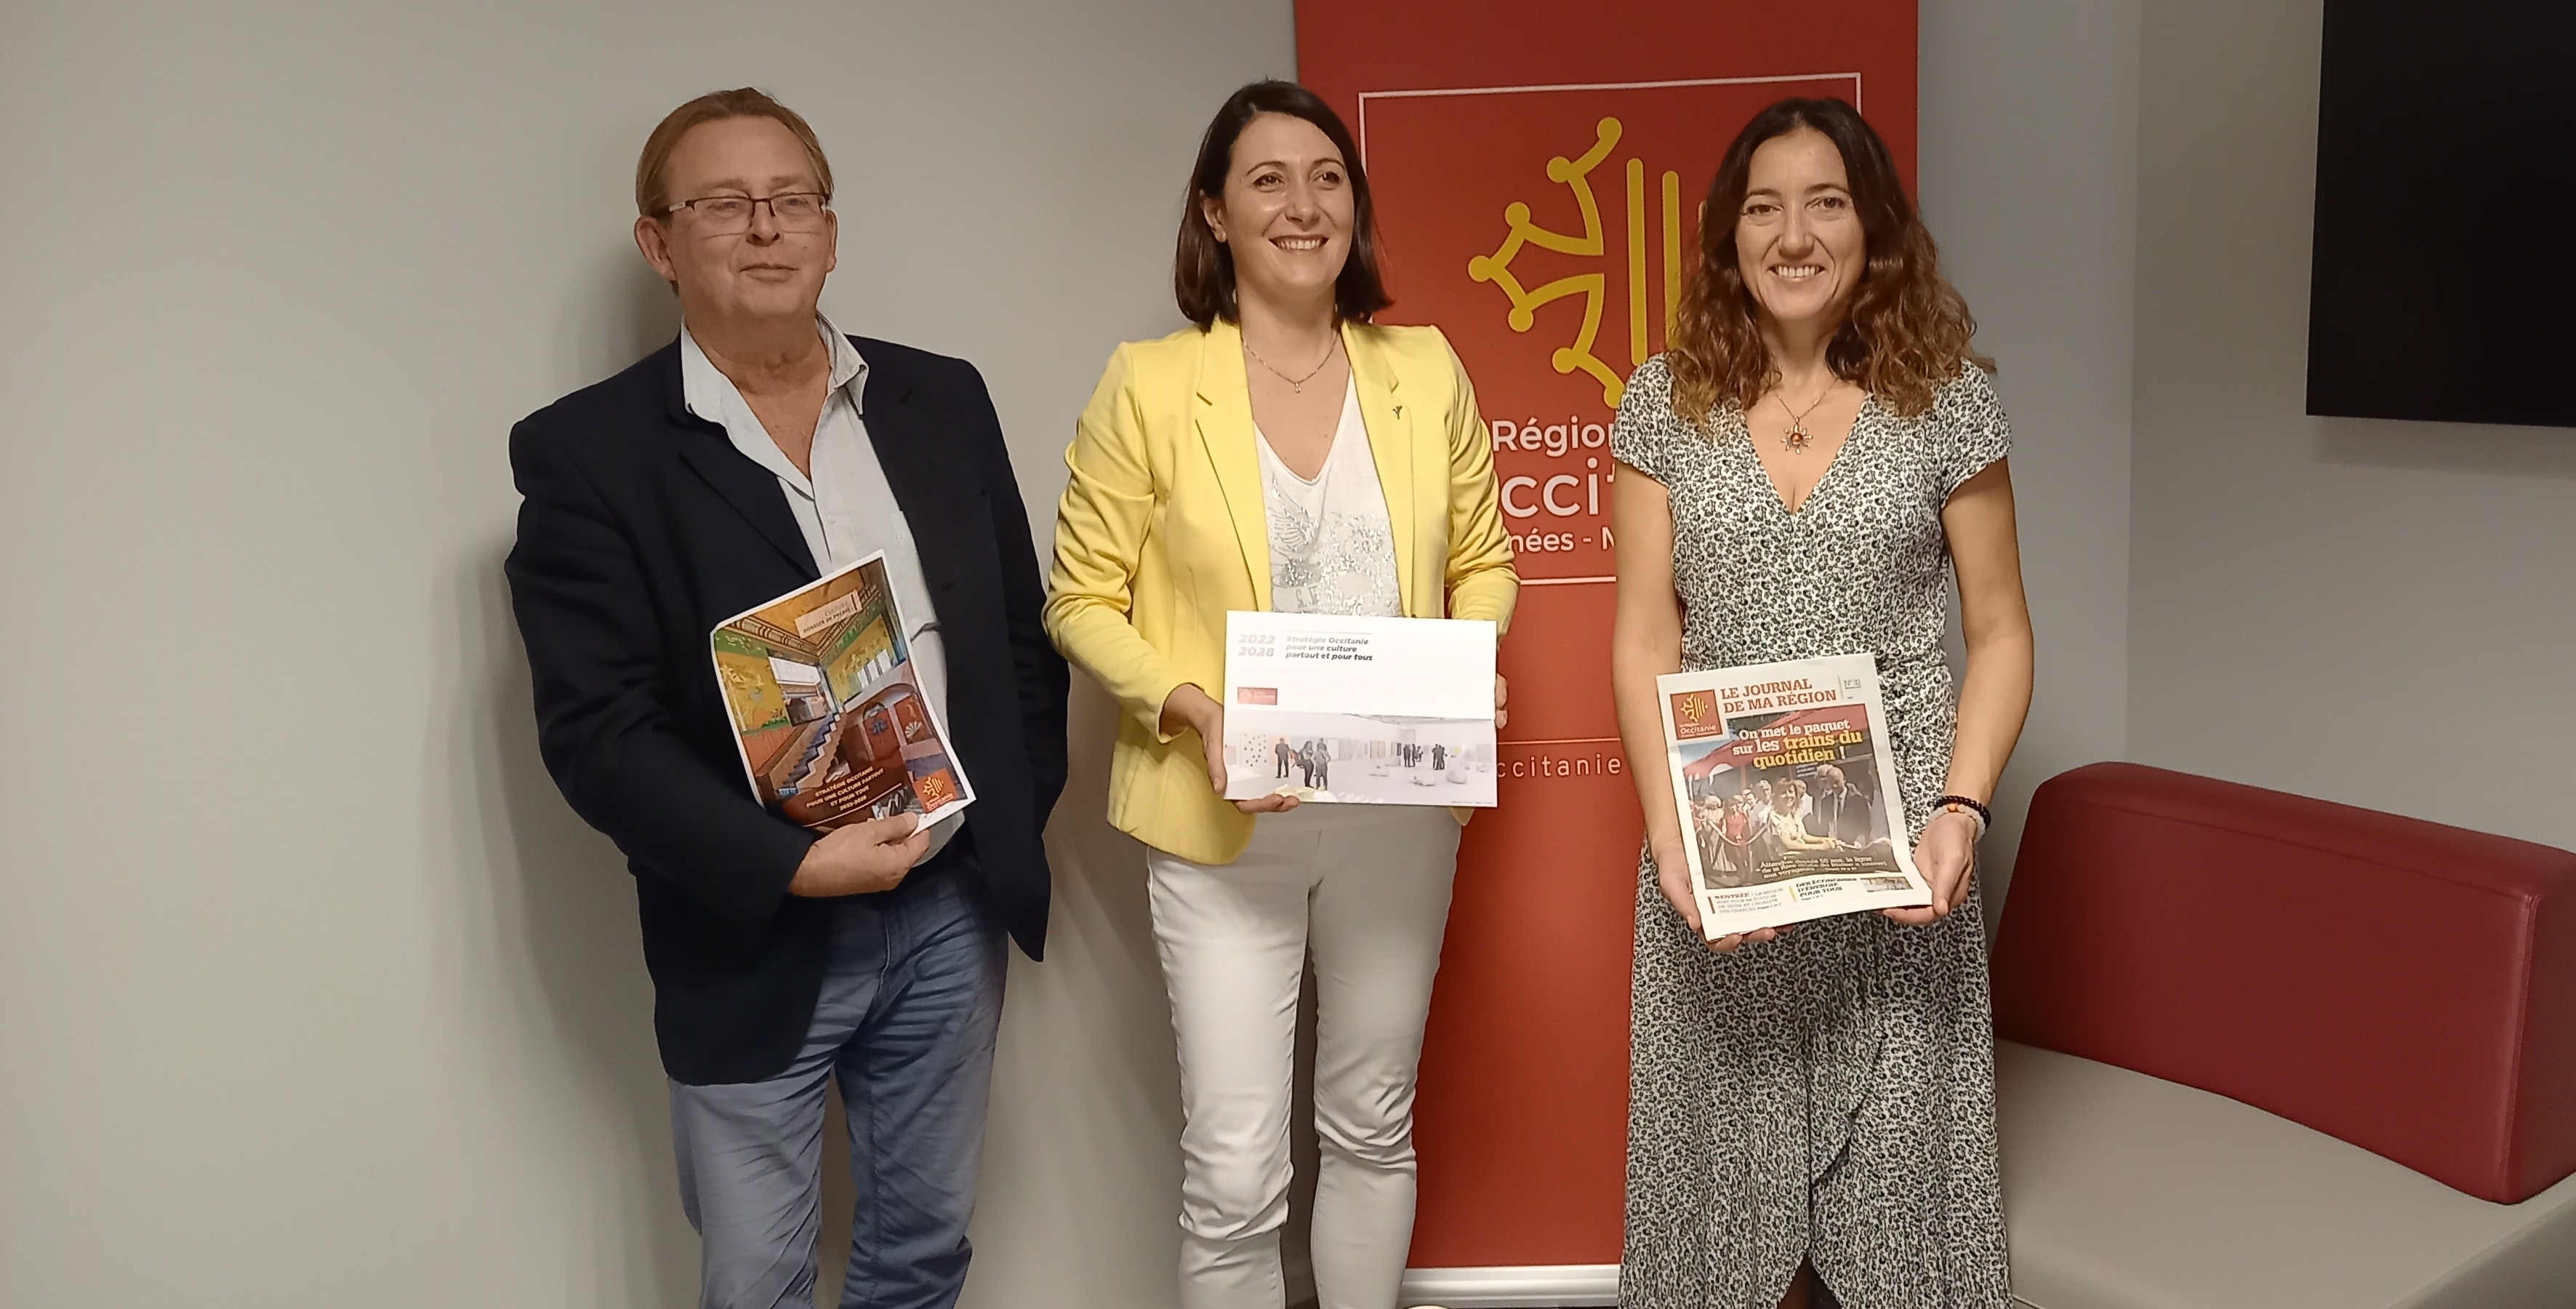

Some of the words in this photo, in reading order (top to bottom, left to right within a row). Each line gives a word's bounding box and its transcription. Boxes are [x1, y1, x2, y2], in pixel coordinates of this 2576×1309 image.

[1510, 527, 1574, 553] nées
[1238, 634, 1275, 644] 2022
[1286, 636, 1326, 644] Stratégie
[1238, 647, 1275, 657] 2028
[1720, 687, 1739, 700] LE
[1742, 678, 1813, 697] JOURNAL
[1723, 700, 1745, 713] DE
[1747, 697, 1774, 710] MA
[1776, 689, 1837, 707] RÉGION
[1680, 724, 1716, 734] Occitanie
[1738, 729, 1758, 740] On
[1761, 726, 1787, 737] met
[1790, 724, 1802, 734] le
[1803, 718, 1851, 736] paquet
[1733, 744, 1753, 756] sur
[1754, 739, 1780, 753] les
[1783, 734, 1835, 750] trains
[1839, 729, 1863, 744] du
[1498, 754, 1621, 777] ccitanie
[1753, 748, 1836, 770] quotidien
[1839, 745, 1846, 760] !
[838, 781, 862, 796] CULTURE
